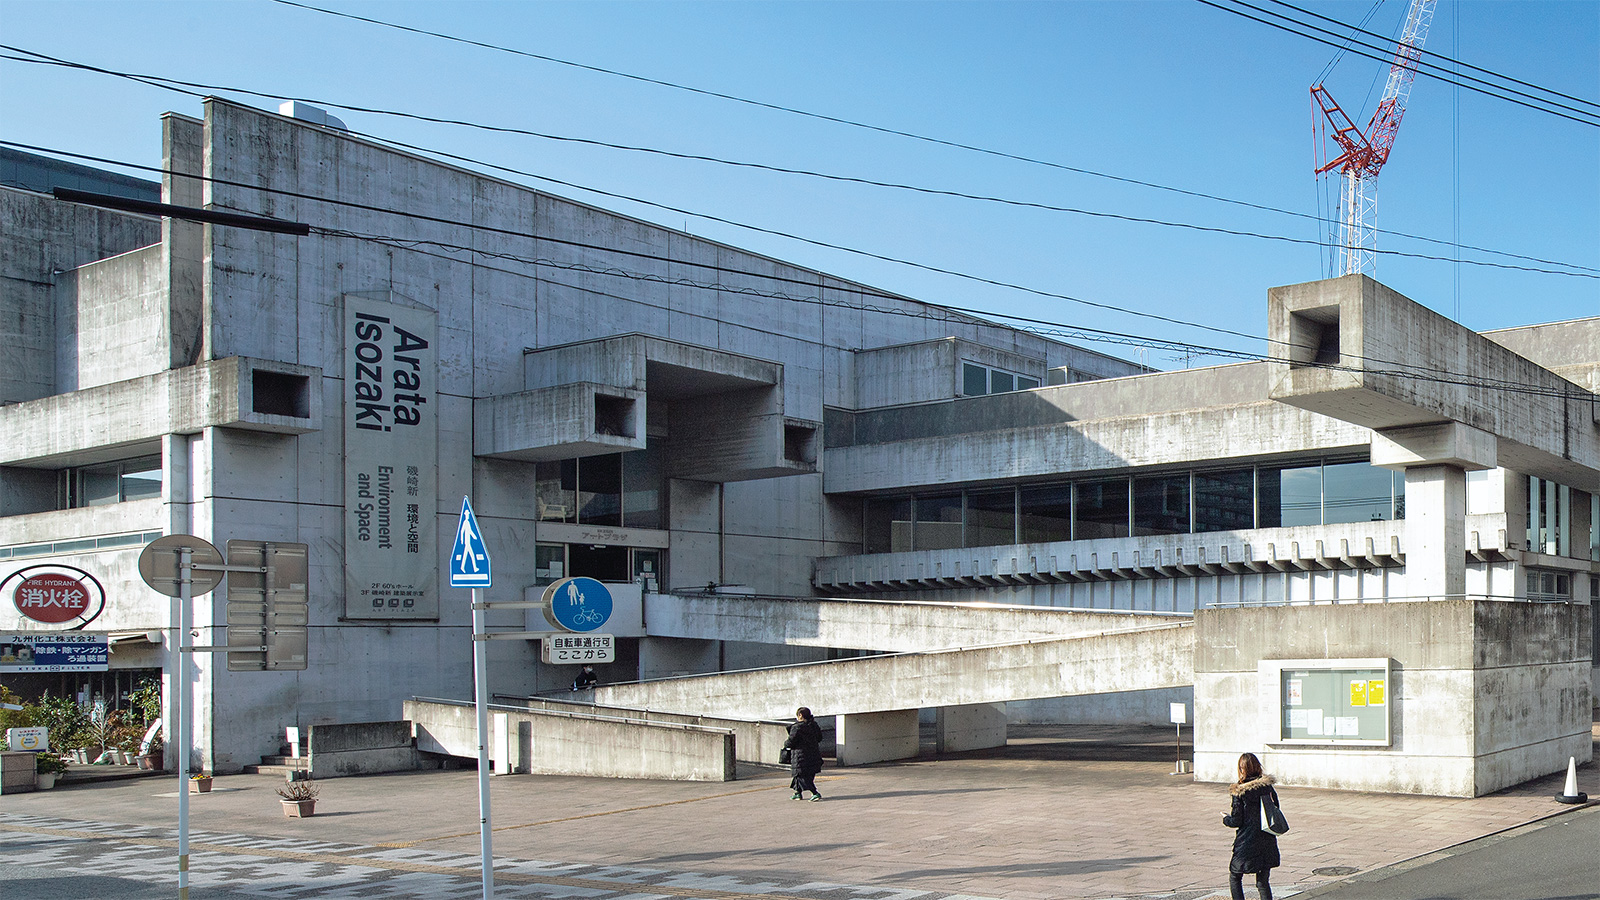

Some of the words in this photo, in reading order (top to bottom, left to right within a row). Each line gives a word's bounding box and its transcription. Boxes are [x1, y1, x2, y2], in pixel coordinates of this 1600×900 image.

[355, 312, 391, 432] Isozaki
[393, 325, 428, 426] Arata
[358, 472, 374, 499] and
[377, 465, 394, 549] Environment
[358, 502, 374, 542] Space
[406, 503, 419, 554] 環境と空間
[21, 588, 84, 609] 消火栓
[12, 635, 97, 643] 九州化工株式会社
[554, 638, 611, 648] 自転車通行可
[67, 654, 107, 663] ろ過装置
[558, 650, 608, 660] ここから
